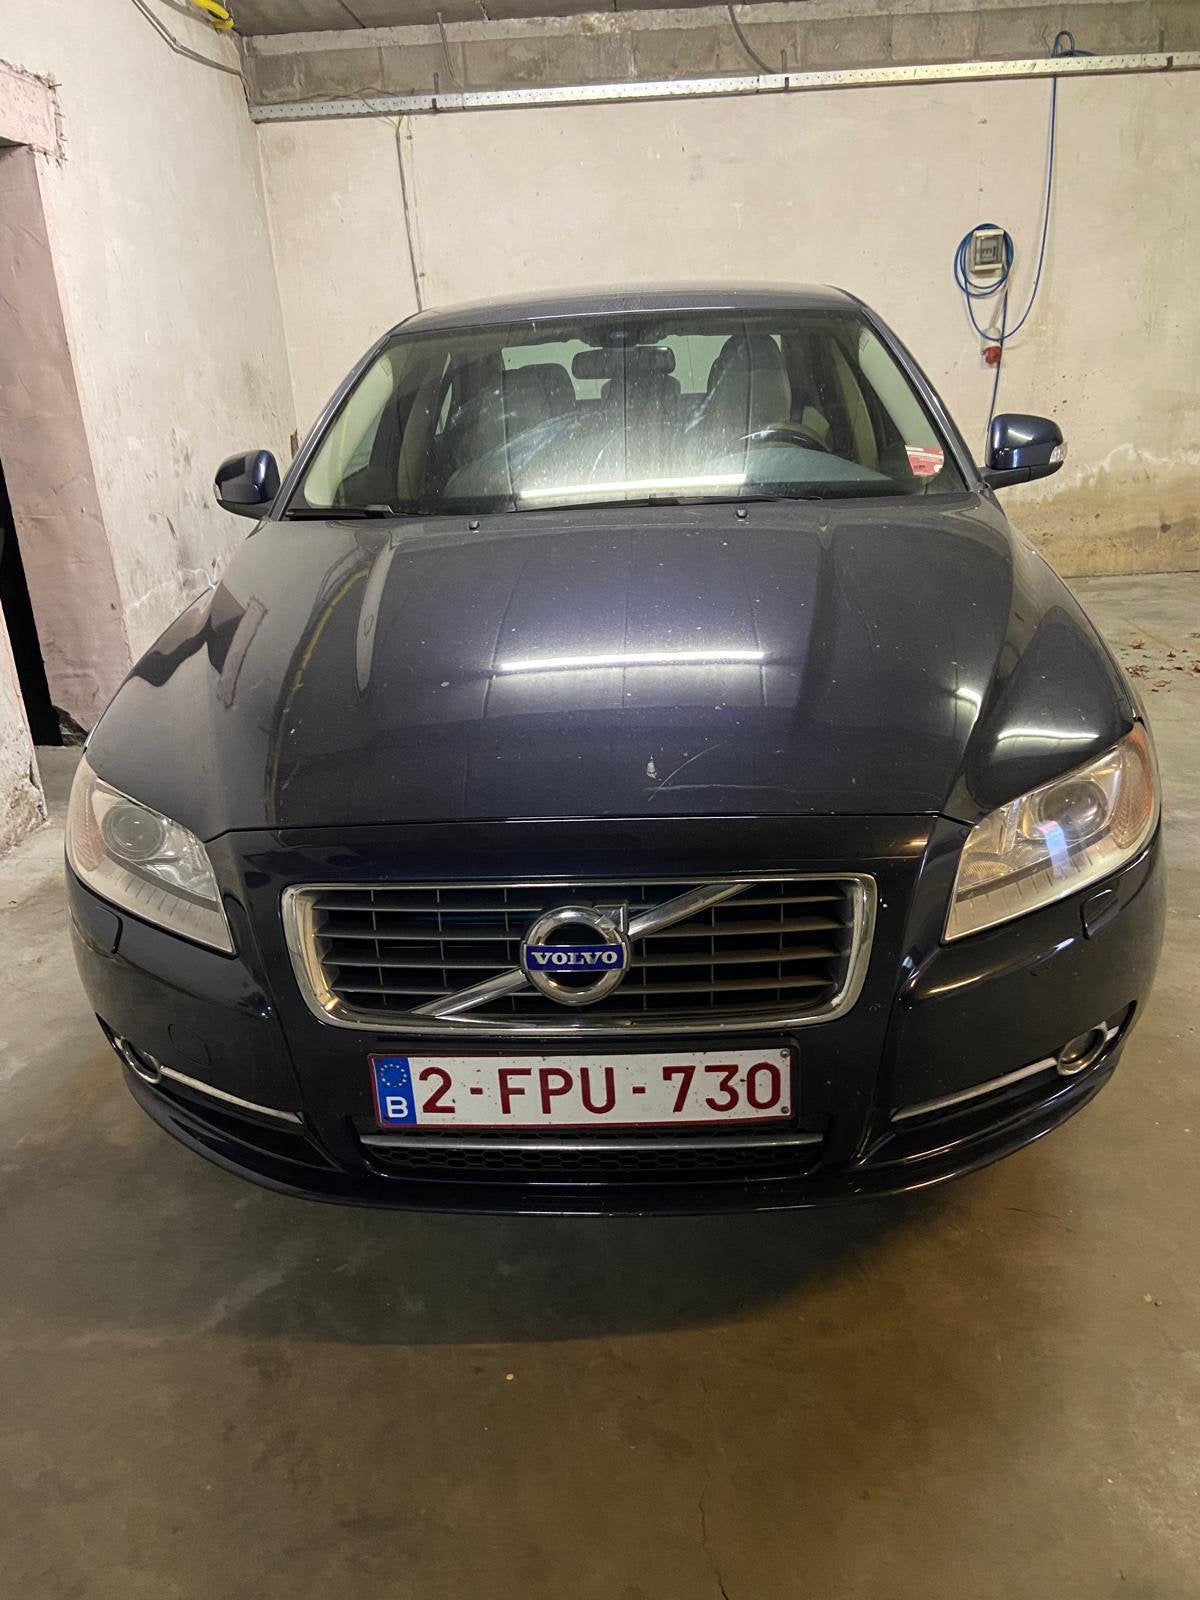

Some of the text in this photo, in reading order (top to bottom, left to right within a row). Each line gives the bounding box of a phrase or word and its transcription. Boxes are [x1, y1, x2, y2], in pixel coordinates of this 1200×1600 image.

[531, 951, 618, 965] VOLVO
[418, 1062, 782, 1115] 2-FPU-730
[386, 1096, 409, 1118] B
